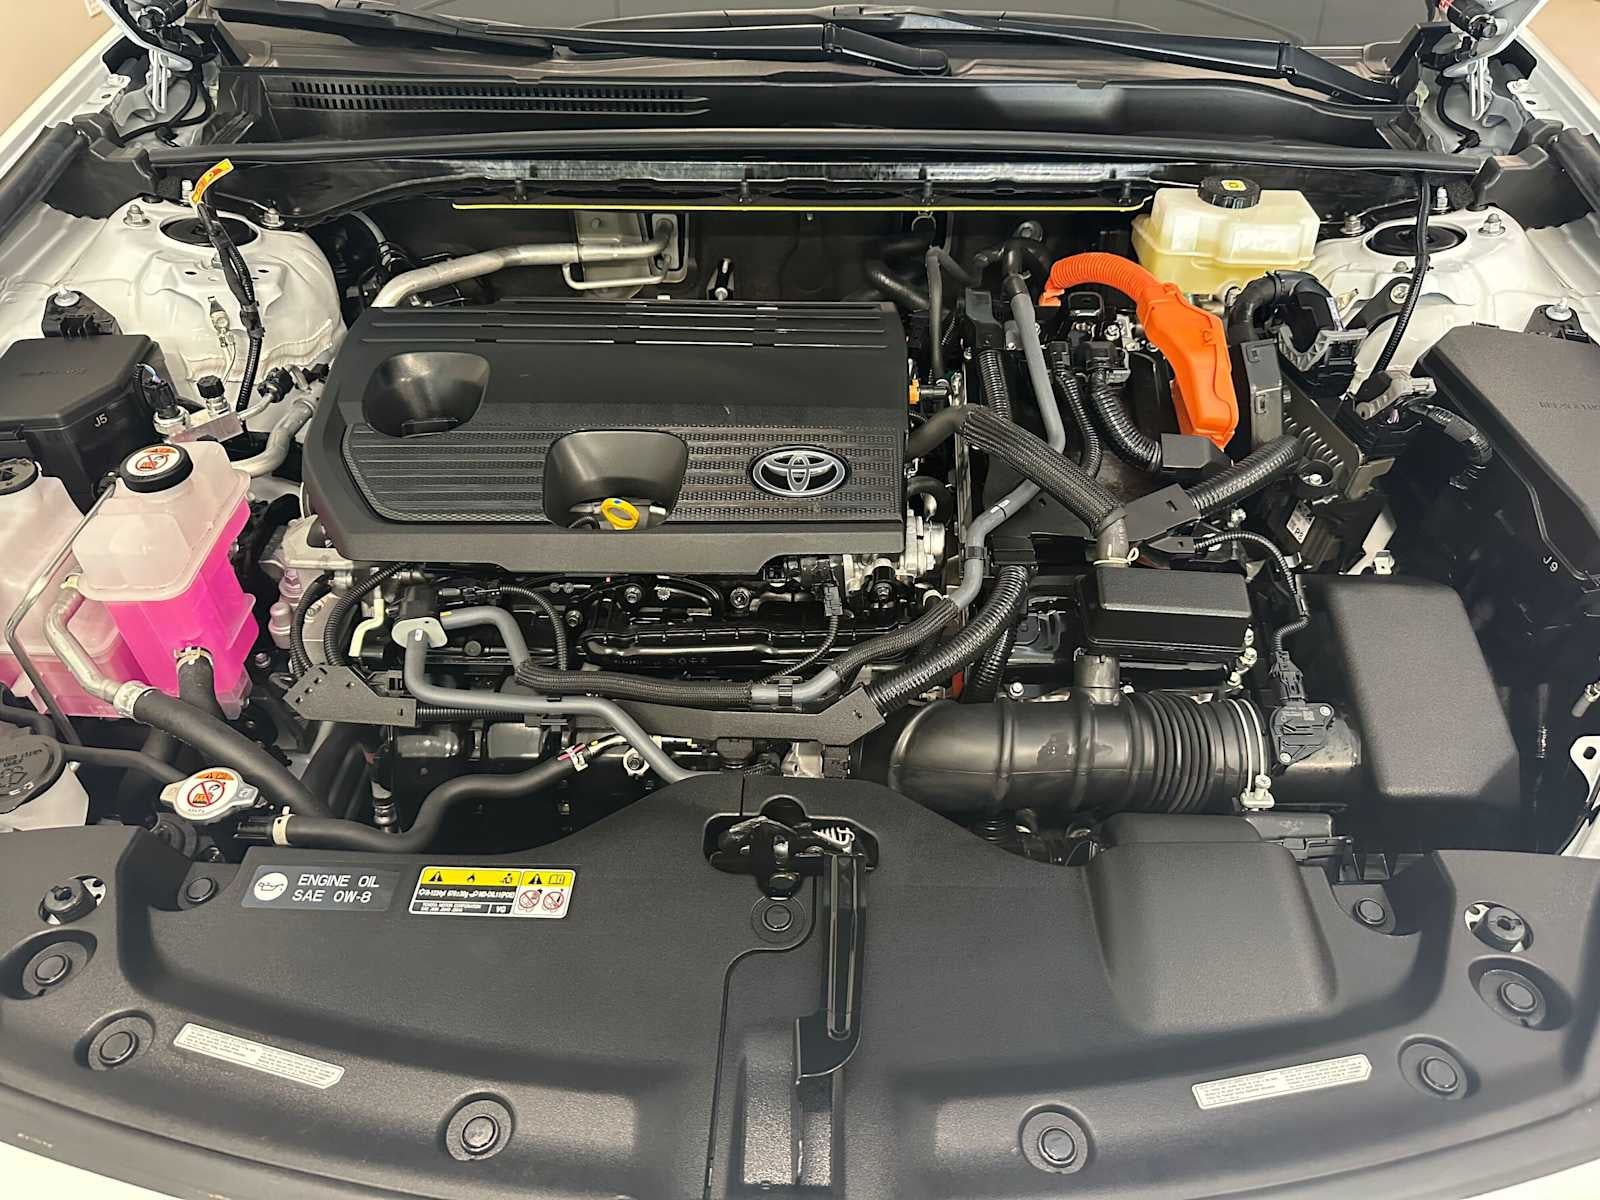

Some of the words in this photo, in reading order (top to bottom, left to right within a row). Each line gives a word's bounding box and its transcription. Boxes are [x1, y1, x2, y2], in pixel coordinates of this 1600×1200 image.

[94, 413, 108, 428] J5
[1542, 556, 1559, 572] J9
[297, 873, 352, 888] ENGINE
[357, 875, 381, 888] OIL
[291, 889, 326, 902] SAE
[333, 890, 373, 903] 0W-8
